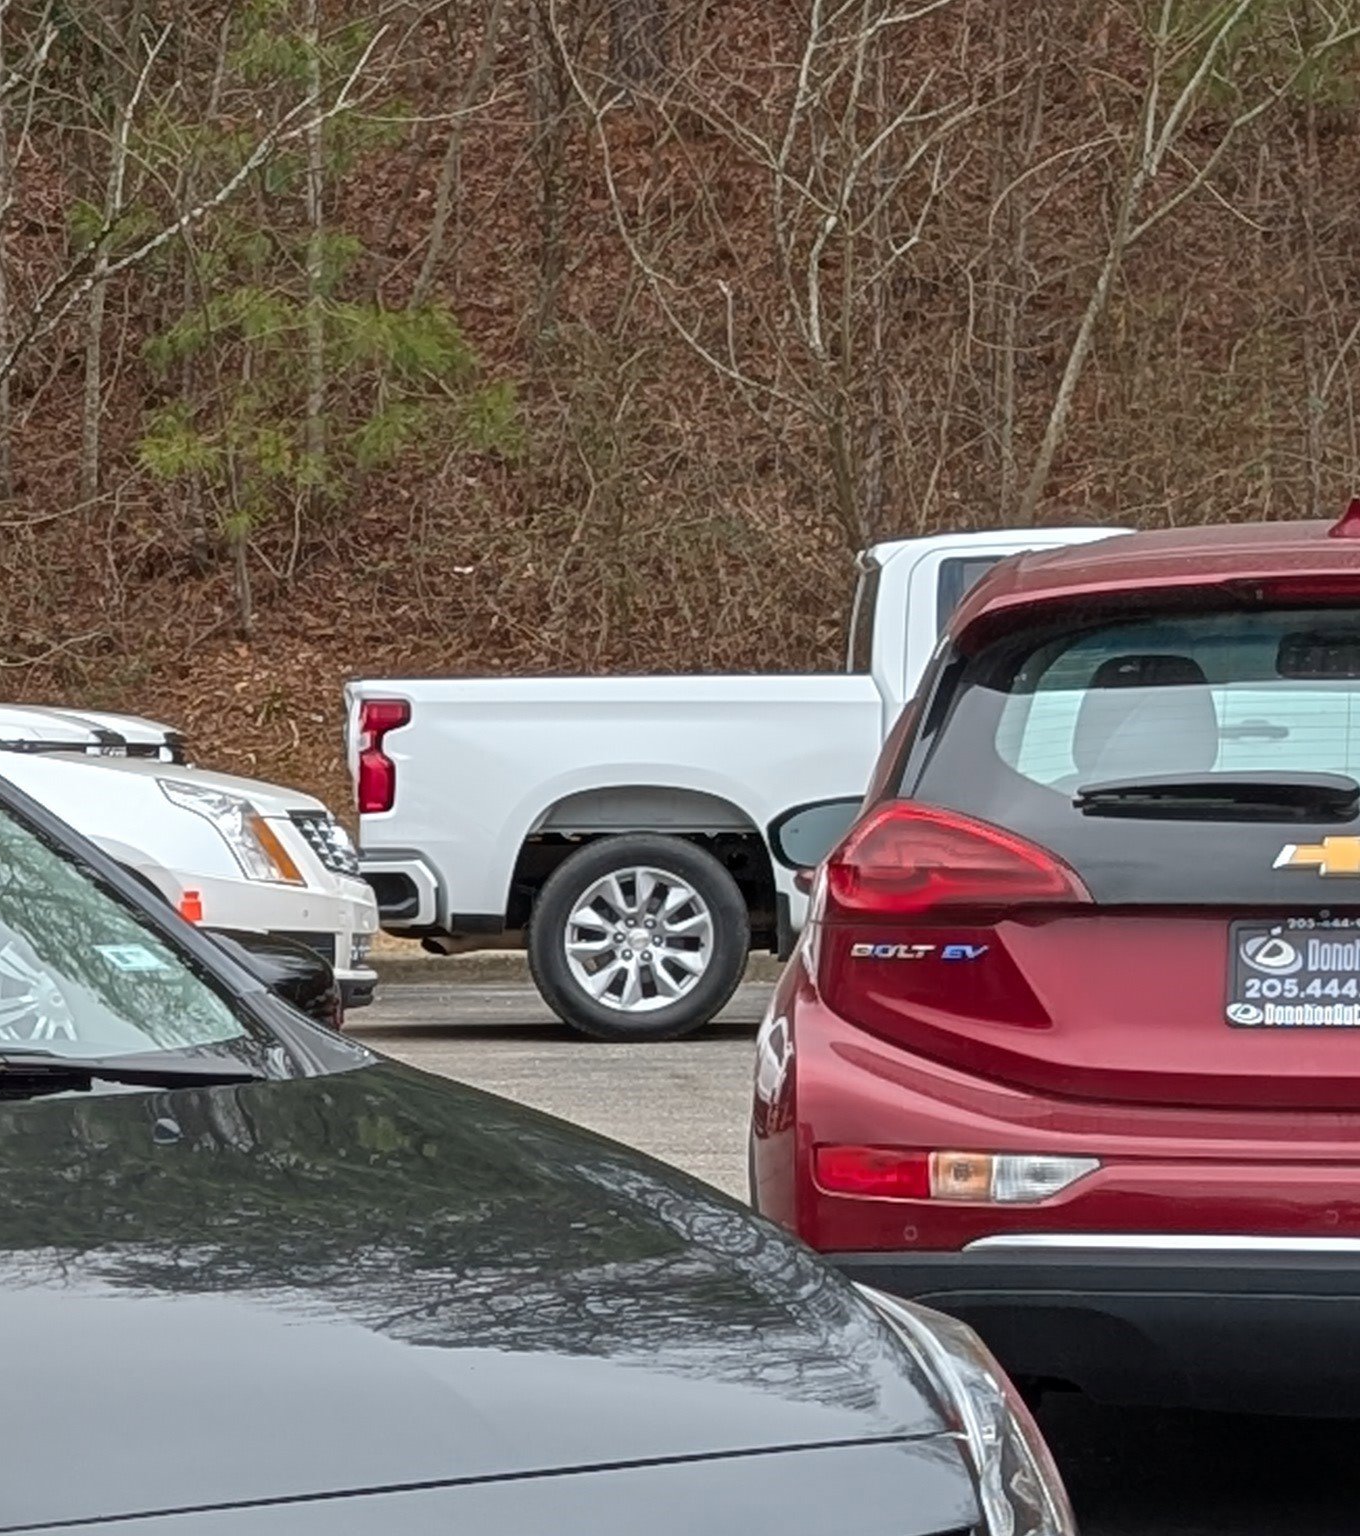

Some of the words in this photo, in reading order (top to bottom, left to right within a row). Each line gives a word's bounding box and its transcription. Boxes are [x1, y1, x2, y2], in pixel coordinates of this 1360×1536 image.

[851, 943, 936, 959] BOLT
[941, 944, 989, 960] EV
[1245, 978, 1360, 998] 205.444
